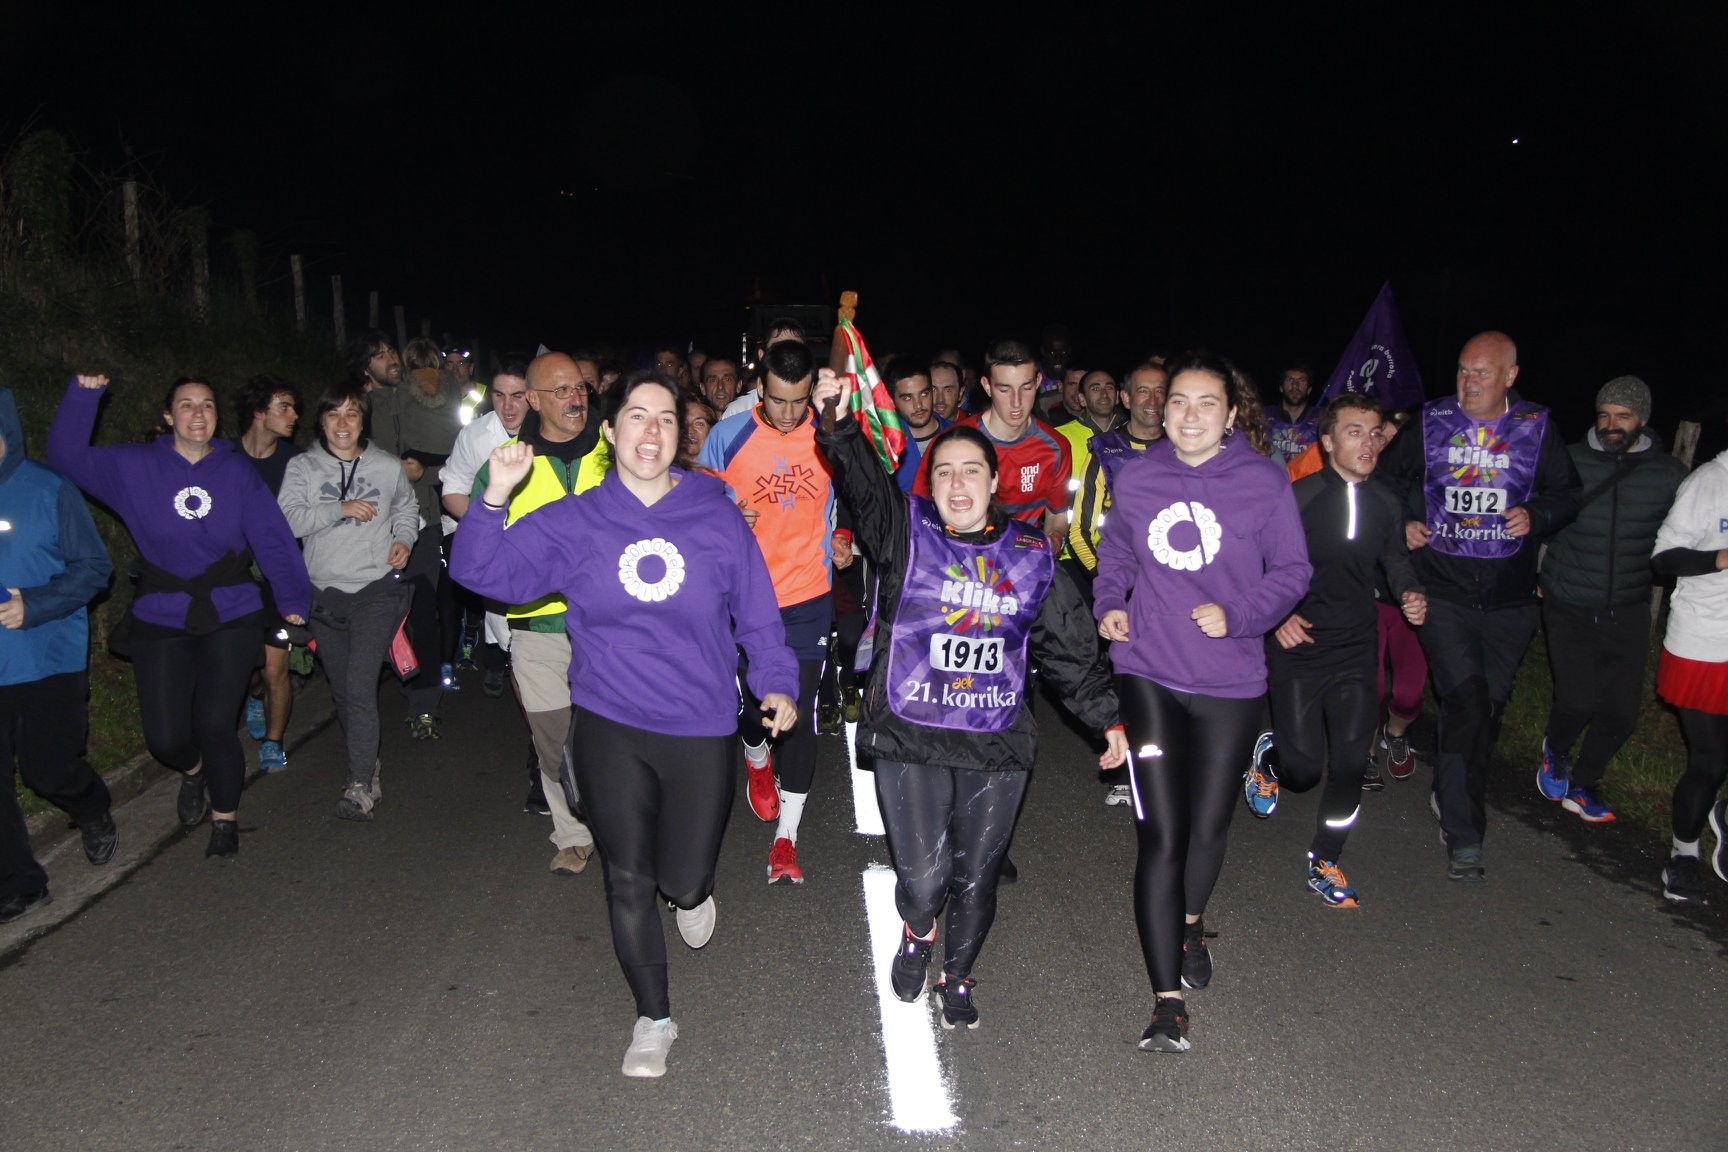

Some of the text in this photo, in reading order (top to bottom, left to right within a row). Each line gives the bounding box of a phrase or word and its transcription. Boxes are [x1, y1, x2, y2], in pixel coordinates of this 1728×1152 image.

[1021, 463, 1040, 475] ond
[1448, 446, 1510, 469] Klika
[1021, 474, 1036, 484] arr
[1021, 483, 1033, 493] oa
[1451, 490, 1499, 513] 1912
[941, 580, 1019, 615] Klika
[942, 639, 999, 672] 1913
[952, 673, 975, 690] aek
[904, 680, 1016, 708] 21. korrika
